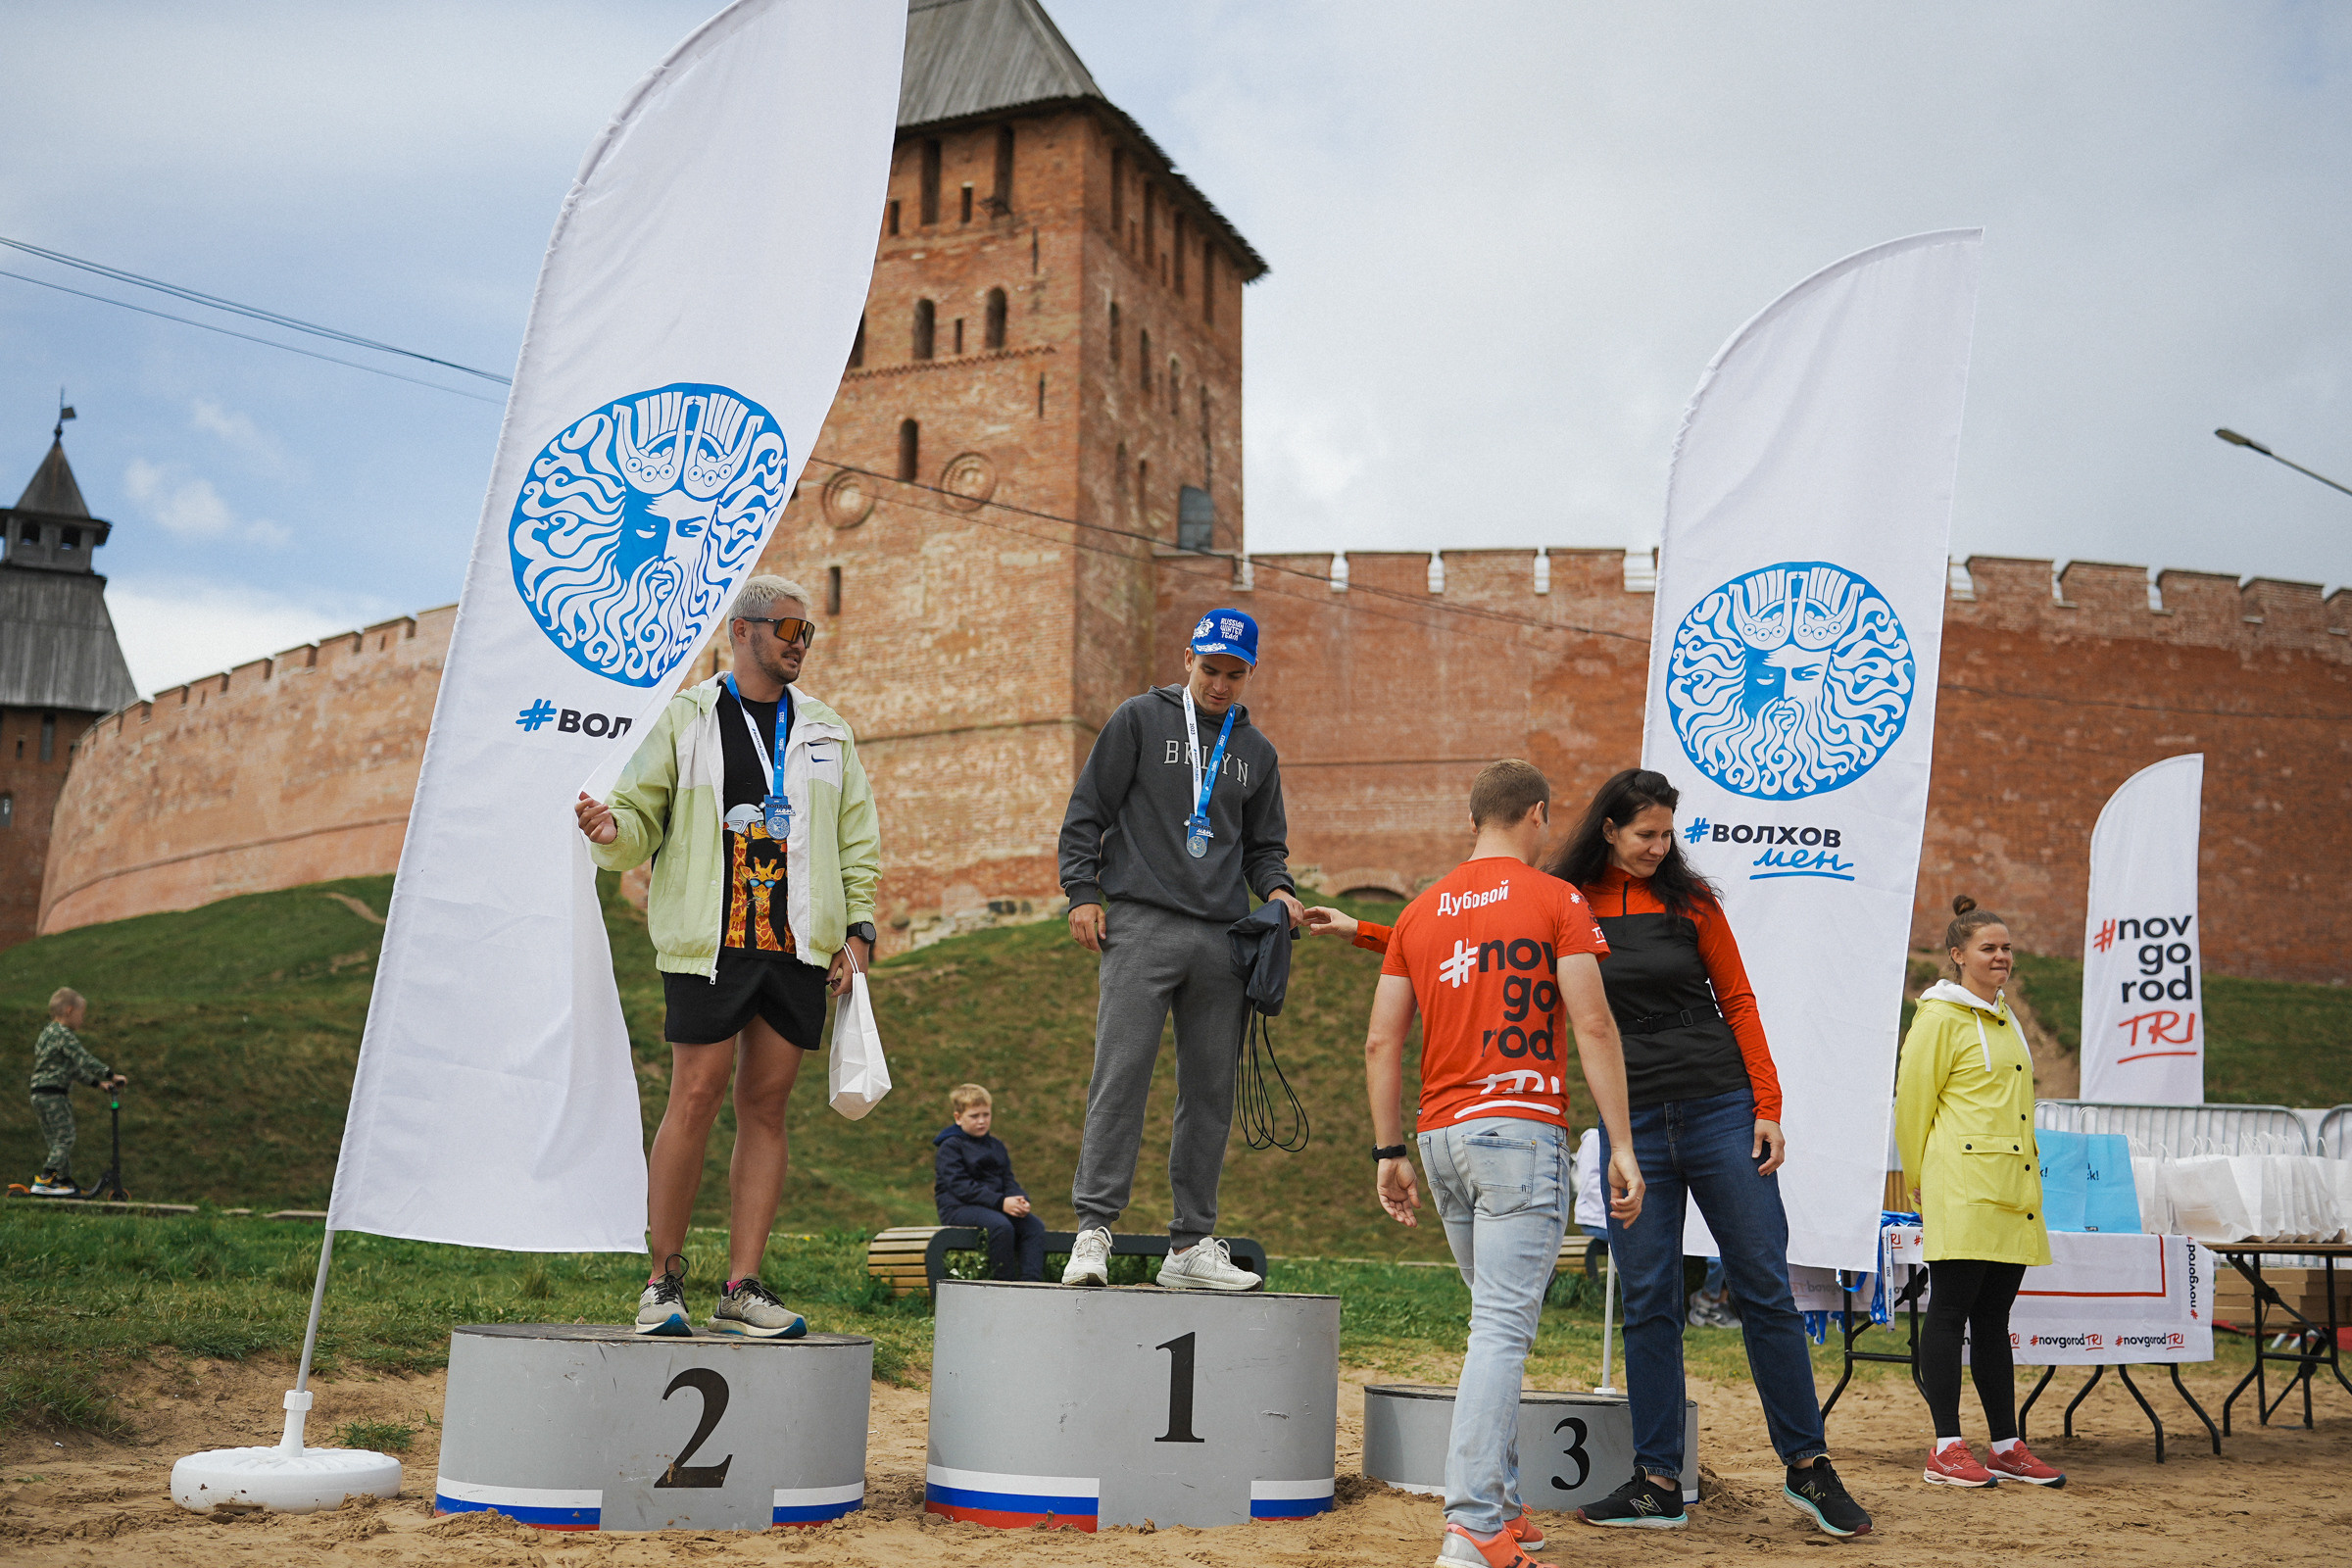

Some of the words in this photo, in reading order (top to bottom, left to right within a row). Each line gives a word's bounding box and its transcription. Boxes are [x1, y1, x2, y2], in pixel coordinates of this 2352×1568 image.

[1220, 617, 1245, 629] RUSSIAN
[1220, 624, 1243, 637] WINTER
[1221, 632, 1239, 642] TEAM
[1751, 848, 1854, 873] мен
[1437, 880, 1509, 917] Дубовой
[2093, 915, 2192, 953] #nov
[2138, 943, 2191, 975] go
[1503, 974, 1557, 1022] go
[2122, 966, 2192, 1003] rod
[1481, 1013, 1556, 1061] rod
[2118, 1010, 2196, 1049] TRI
[1154, 1332, 1205, 1444] 1
[654, 1368, 733, 1489] 2
[1551, 1417, 1591, 1491] 3
